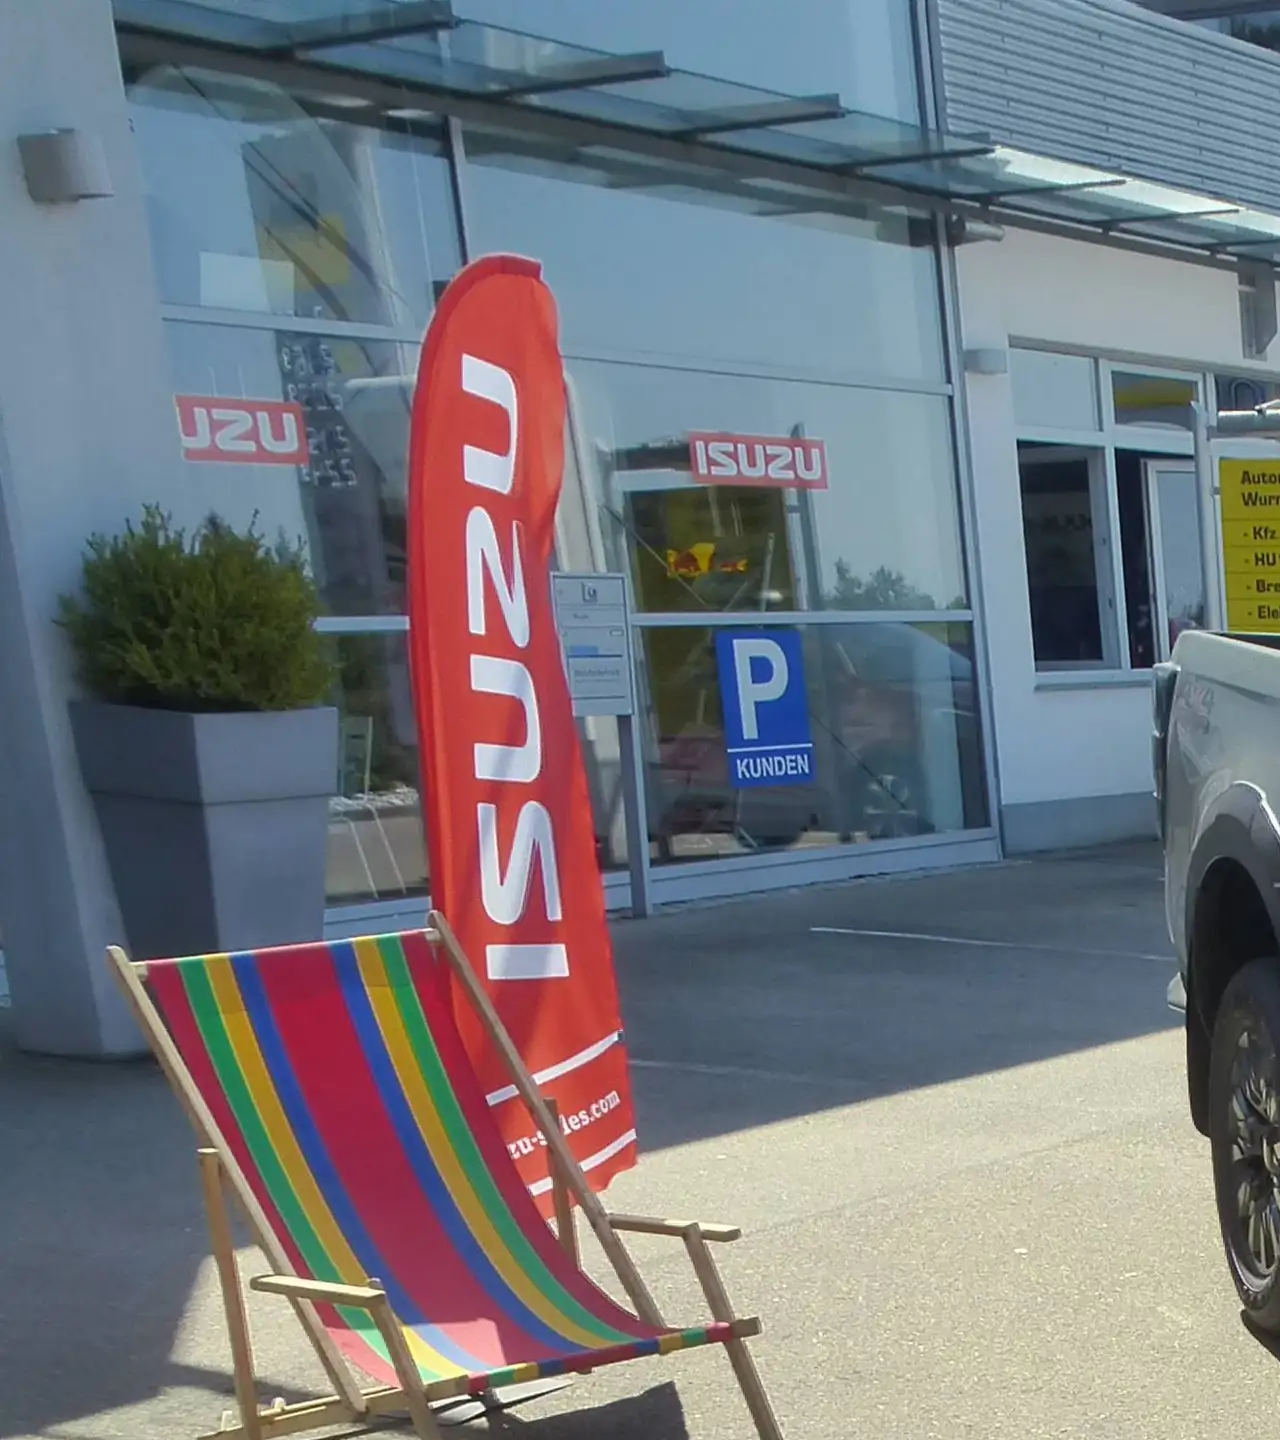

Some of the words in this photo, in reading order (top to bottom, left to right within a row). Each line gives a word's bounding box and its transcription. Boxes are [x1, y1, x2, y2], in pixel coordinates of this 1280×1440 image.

[695, 440, 821, 480] ISUZU
[462, 353, 569, 979] ISUZU
[732, 638, 789, 740] P
[736, 754, 810, 779] KUNDEN
